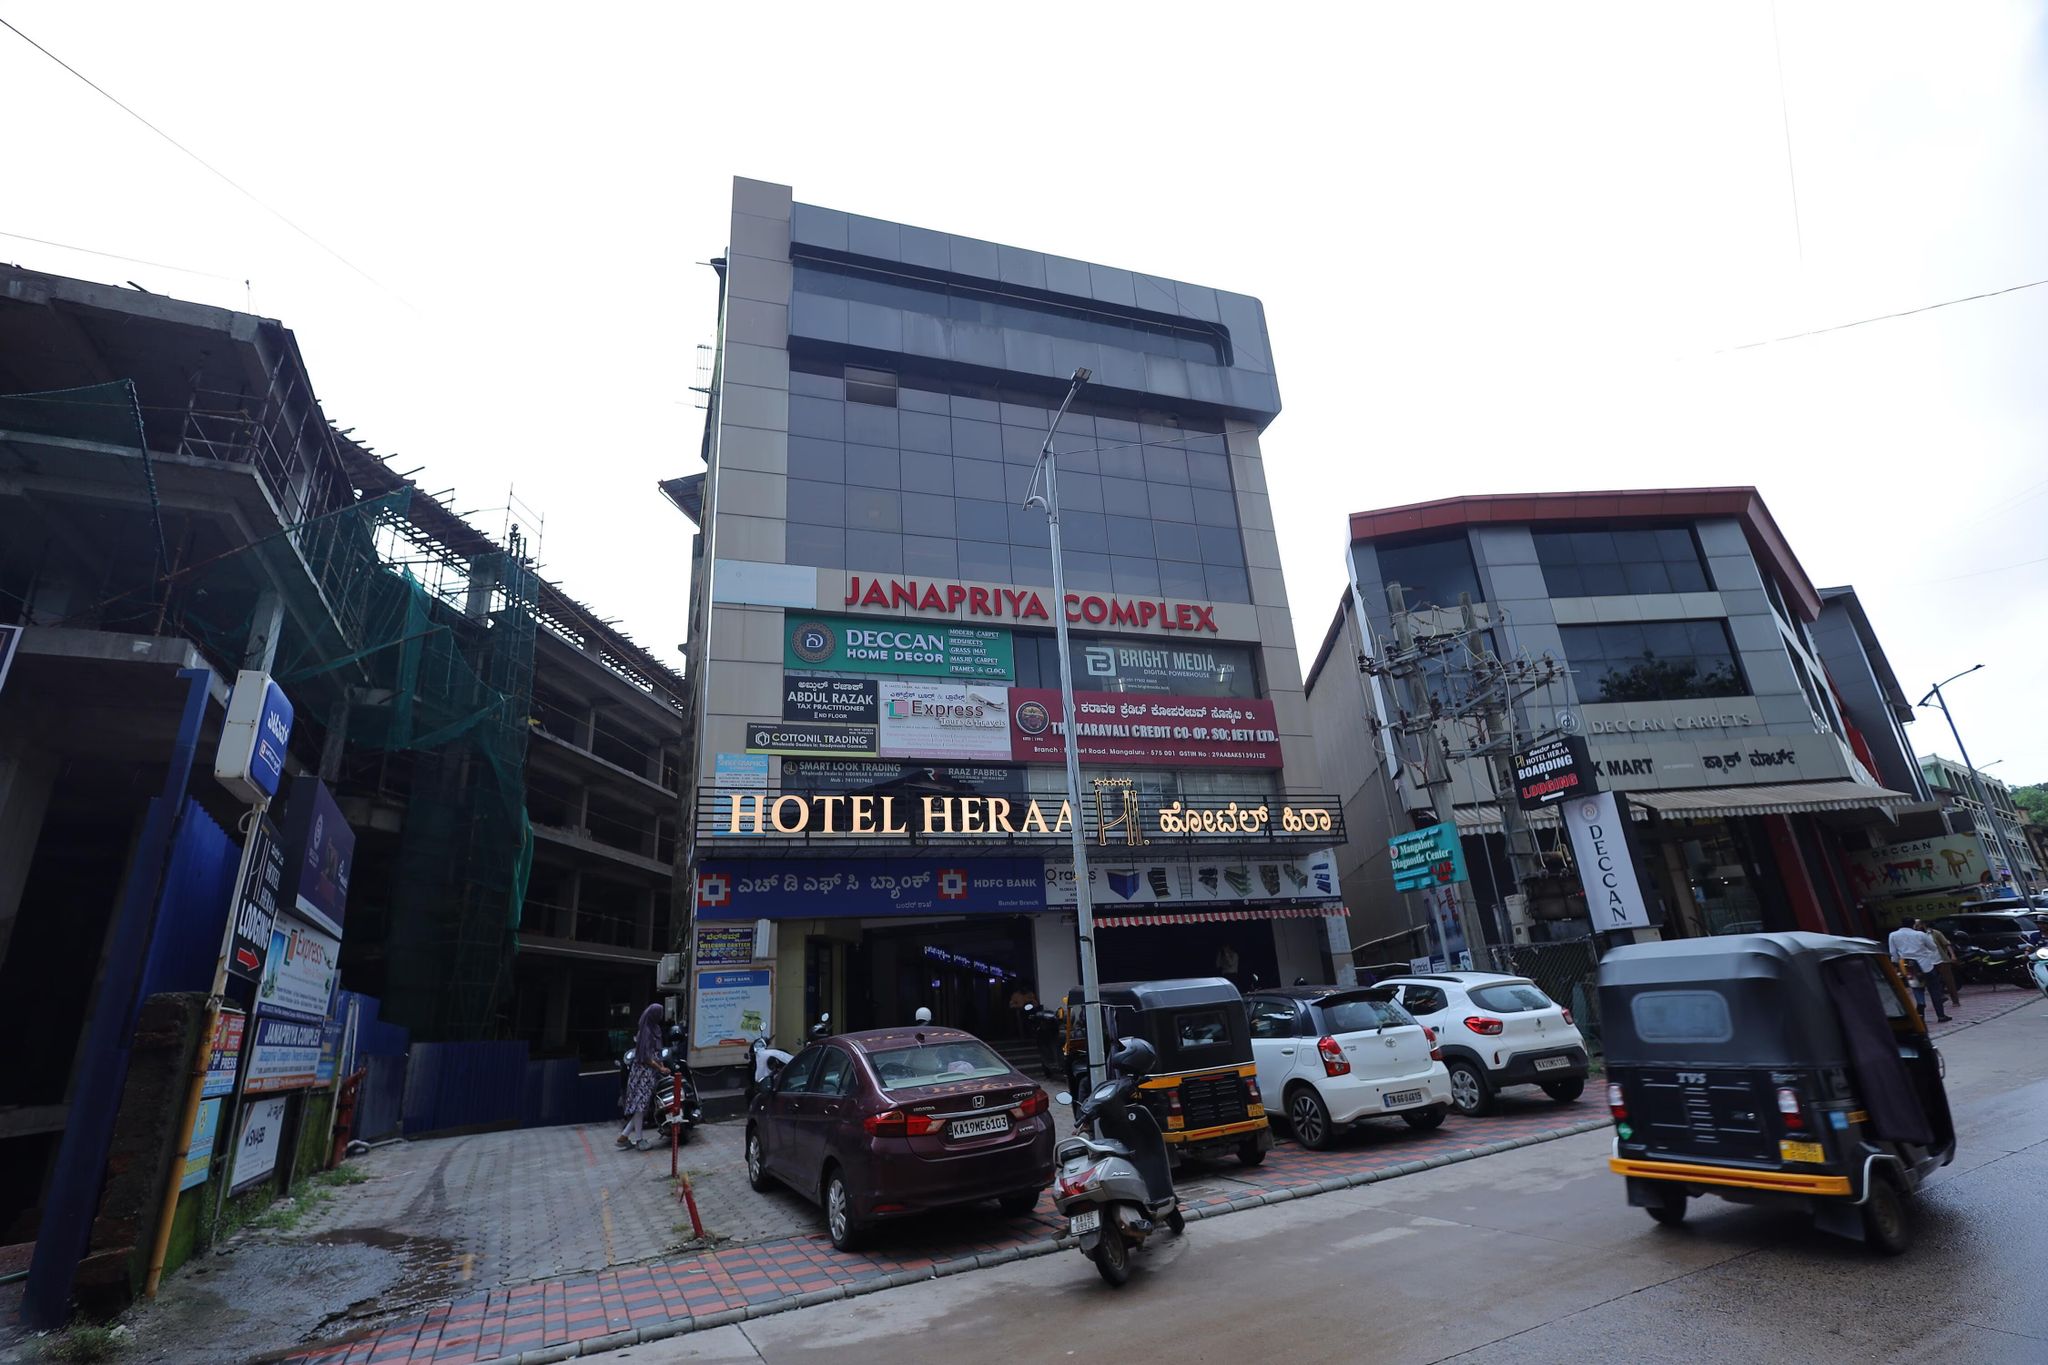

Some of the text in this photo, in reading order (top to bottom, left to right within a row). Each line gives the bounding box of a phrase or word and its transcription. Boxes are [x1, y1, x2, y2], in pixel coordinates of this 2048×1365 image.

[845, 576, 1219, 632] JANAPRIYA COMPLEX
[846, 629, 943, 650] DECCAN
[950, 629, 974, 637] MODERN
[950, 638, 983, 646] BEDSHEETS
[847, 649, 944, 663] HOME DECOR
[1119, 648, 1169, 669] BRIGHT
[1172, 651, 1216, 672] MEDIA
[951, 665, 974, 673] FRAMES
[1168, 670, 1209, 678] POWERHOUSE
[787, 691, 874, 705] ABDUL RAZAK
[813, 704, 865, 712] PRACTITIONER
[912, 700, 984, 719] Express
[940, 717, 964, 727] Tours
[966, 719, 973, 727] &
[975, 719, 1006, 728] Travels
[1592, 713, 1752, 735] DECCAN CARPETS
[771, 733, 868, 744] COTTONIL TRADING
[1077, 723, 1130, 737] KARAVALI
[1131, 724, 1171, 739] CREDIT
[1211, 728, 1255, 742] SOCIETY
[1256, 730, 1279, 742] LTD.
[1109, 749, 1145, 757] Mangaluru
[1525, 746, 1570, 766] HOTEL HERAA
[1702, 751, 1741, 774] ಪ್ಯಾಕ್
[799, 761, 901, 773] SMART LOOK TRADING
[948, 768, 971, 776] RAAZ
[973, 768, 1008, 777] FABRICS
[1517, 754, 1574, 780] BOARDING
[1606, 758, 1654, 777] MART
[1522, 773, 1579, 799] LODGING
[728, 794, 1073, 835] HOTEL HERAA
[1158, 801, 1332, 833] ಹೋಟೆಲ್ ಹಿರಾ
[1399, 838, 1434, 855] Mangalore
[1872, 841, 1931, 859] DECCAN
[1391, 849, 1450, 870] Diagnostic Center
[1430, 861, 1453, 875] LAB
[264, 860, 281, 892] HOTEL
[1589, 824, 1627, 921] DECCAN
[783, 874, 798, 892] ಡಿ
[846, 873, 860, 891] ಸಿ
[870, 871, 931, 900] ಬ್ಯಾಂಕ್
[974, 878, 1037, 888] HDFC BANK
[1897, 901, 1958, 913] DECCAN
[237, 898, 272, 952] LODGING
[297, 928, 322, 965] Express
[264, 1022, 300, 1045] JANAPRIYA
[297, 1026, 322, 1047] COMPLEX
[220, 1056, 238, 1070] PRESS
[1675, 1072, 1707, 1084] TVS
[953, 1117, 1007, 1136] KA19ME6103
